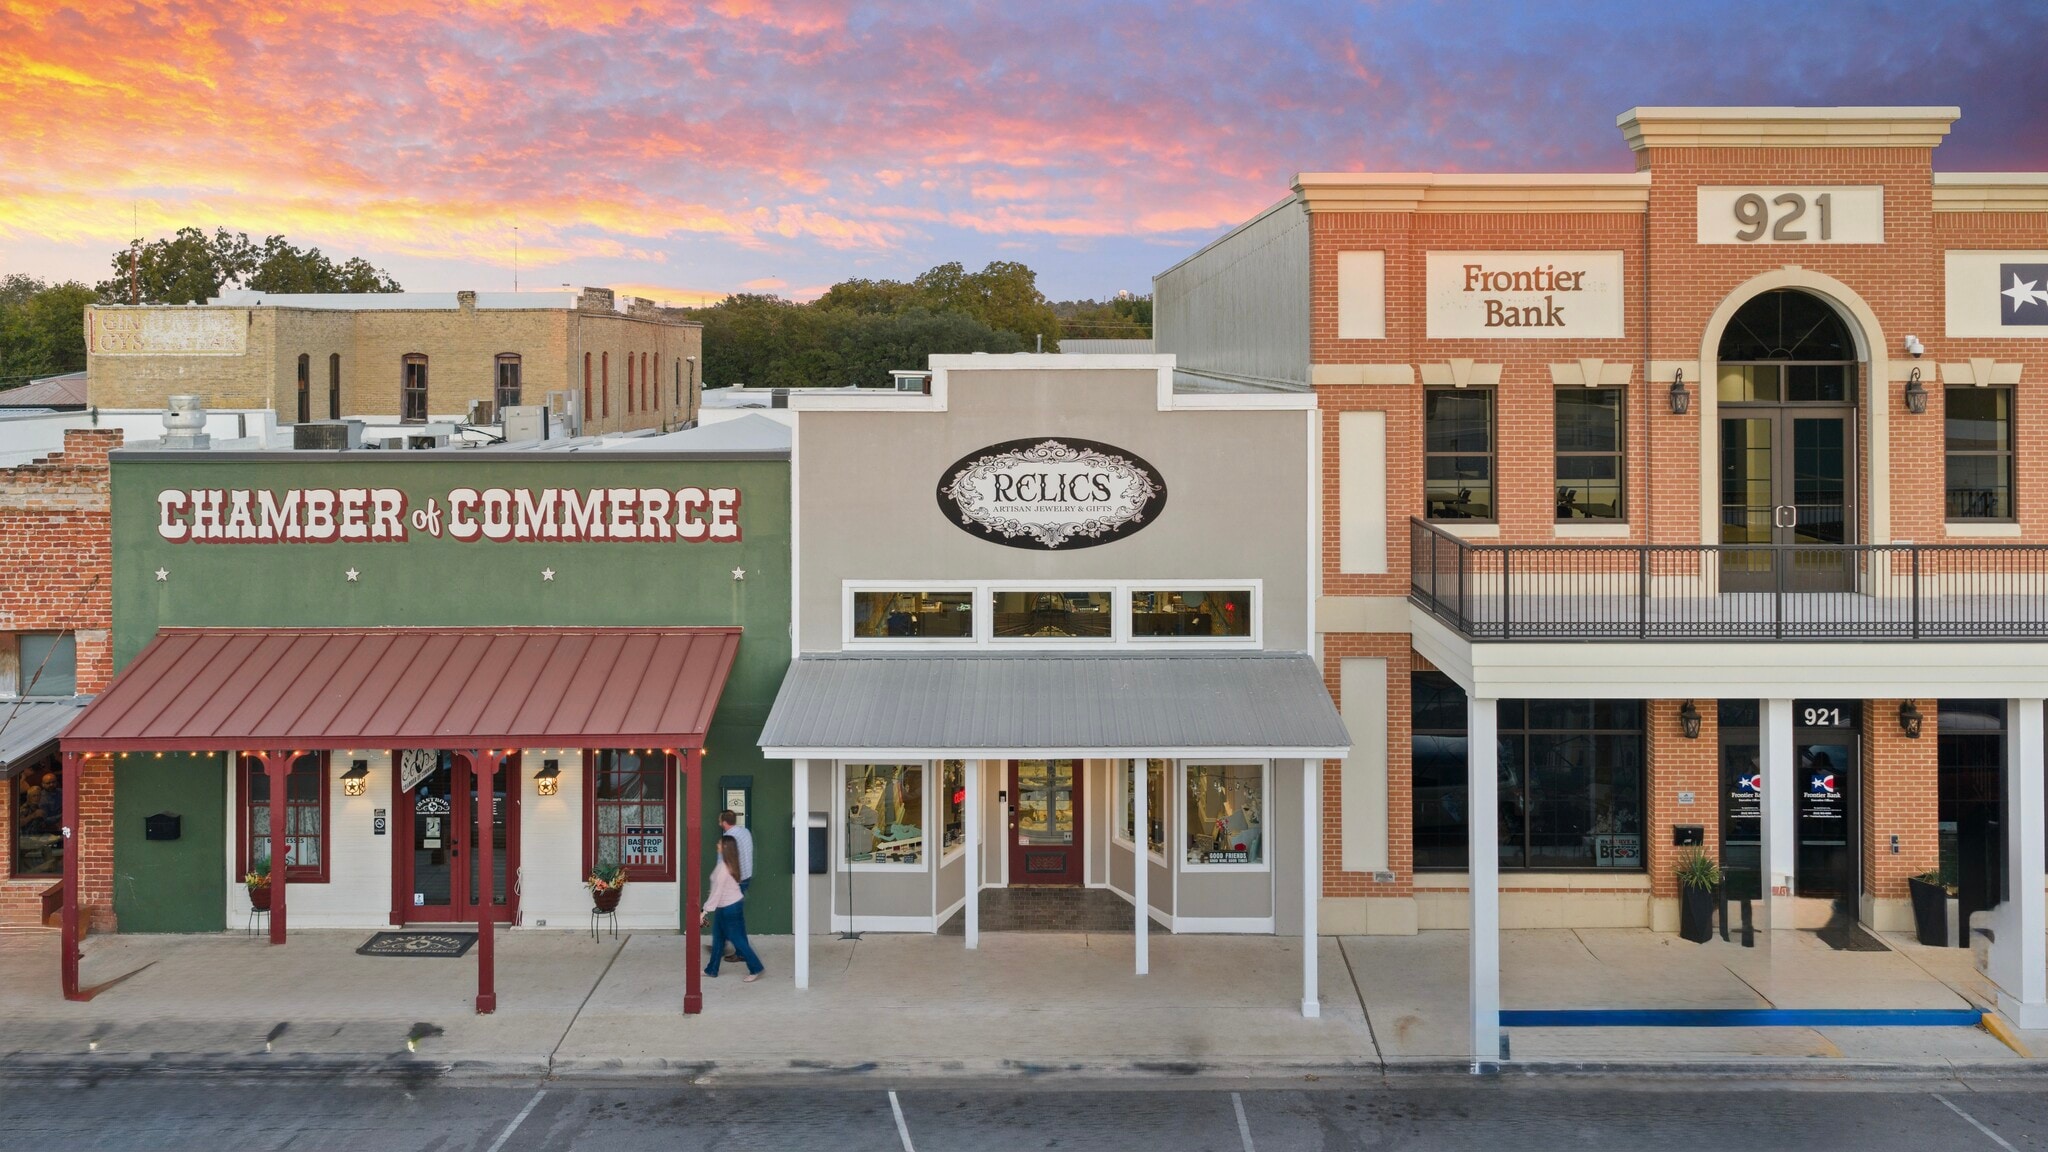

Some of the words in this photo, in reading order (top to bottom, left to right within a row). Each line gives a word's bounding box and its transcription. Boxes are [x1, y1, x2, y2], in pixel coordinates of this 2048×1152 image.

[1734, 192, 1832, 242] 921
[1462, 263, 1586, 292] Frontier
[1483, 295, 1566, 328] Bank
[993, 472, 1112, 503] RELICS
[156, 488, 408, 544] CHAMBER
[411, 497, 442, 539] of
[447, 487, 743, 543] COMMERCE
[993, 505, 1032, 513] ARTISAN
[1034, 505, 1077, 513] JEWELRY
[1086, 505, 1112, 513] GIFTS
[1804, 707, 1840, 726] 921
[627, 838, 663, 846] BASTROP
